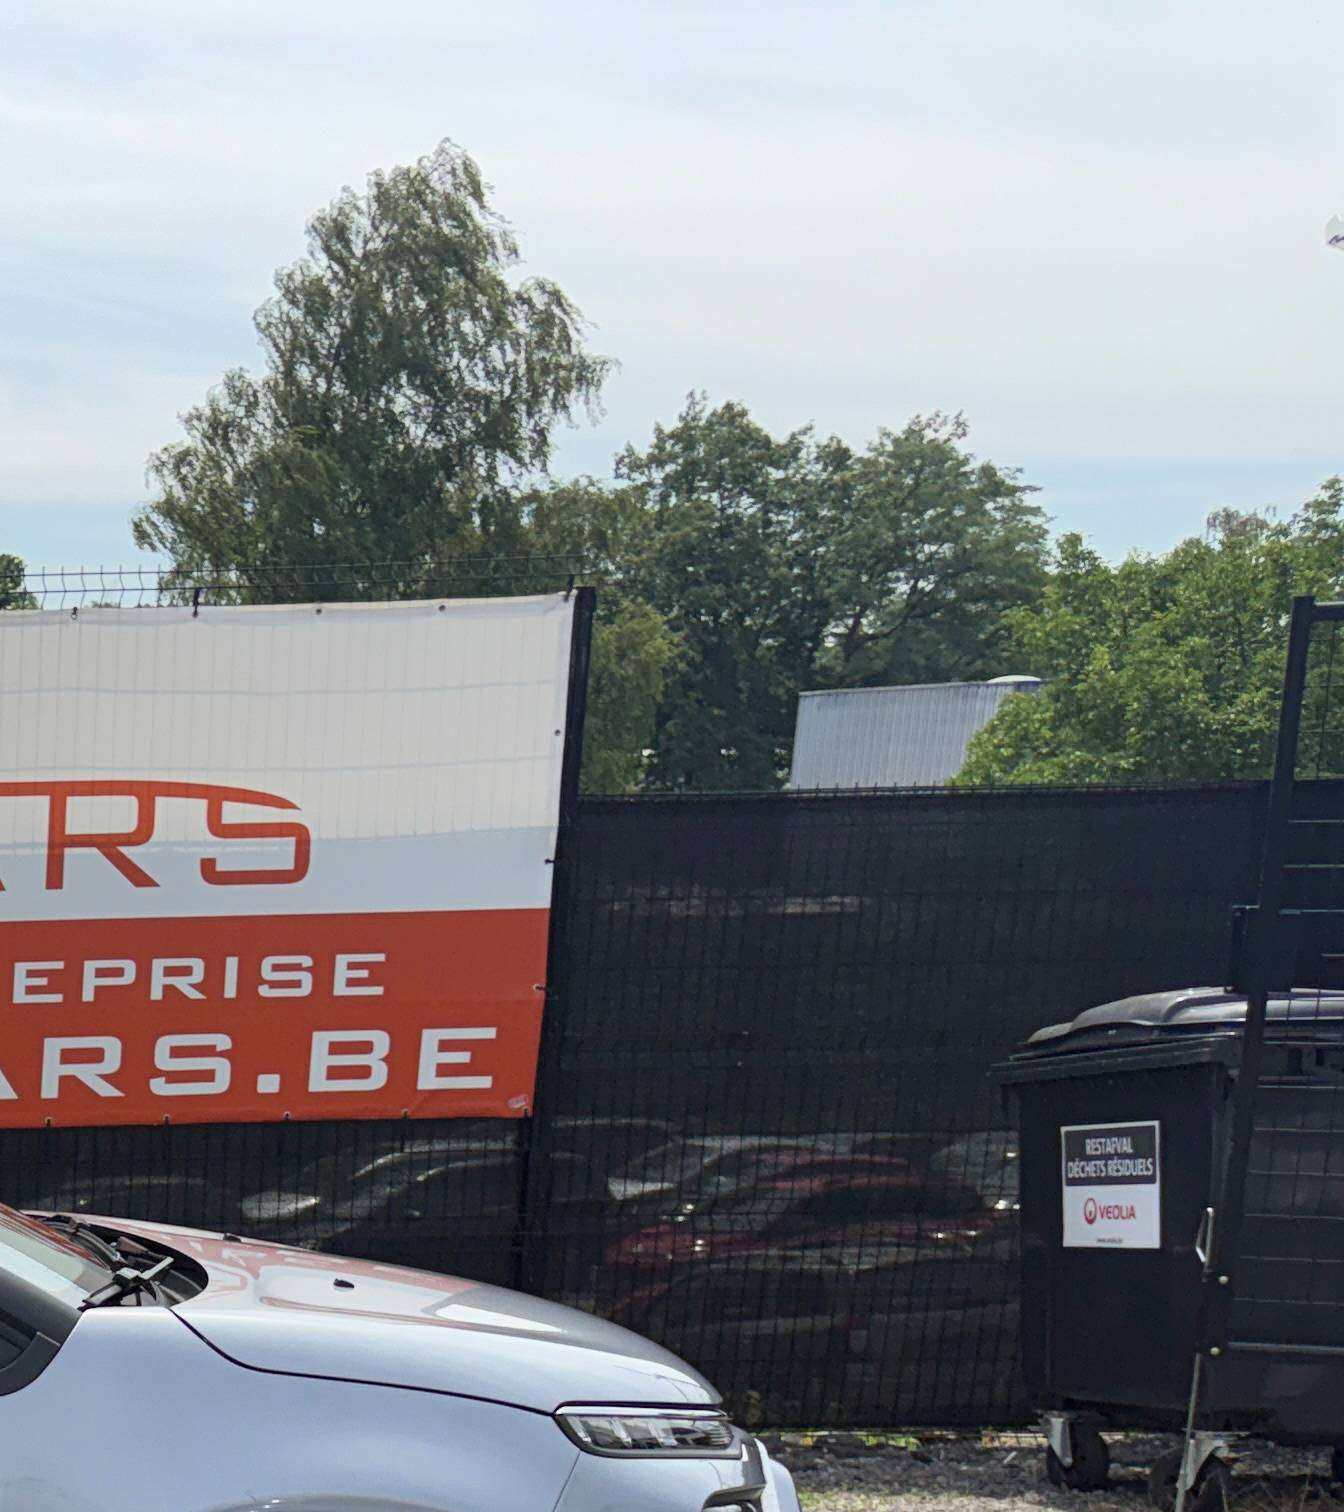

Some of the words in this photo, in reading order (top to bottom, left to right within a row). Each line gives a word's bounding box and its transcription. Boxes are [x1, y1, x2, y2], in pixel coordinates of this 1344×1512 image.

[1085, 1137, 1134, 1155] RESTAFVAL
[1067, 1158, 1106, 1178] DÉCHETS
[1107, 1156, 1153, 1177] RÉSIDUELS
[1099, 1205, 1136, 1220] VEOLIA
